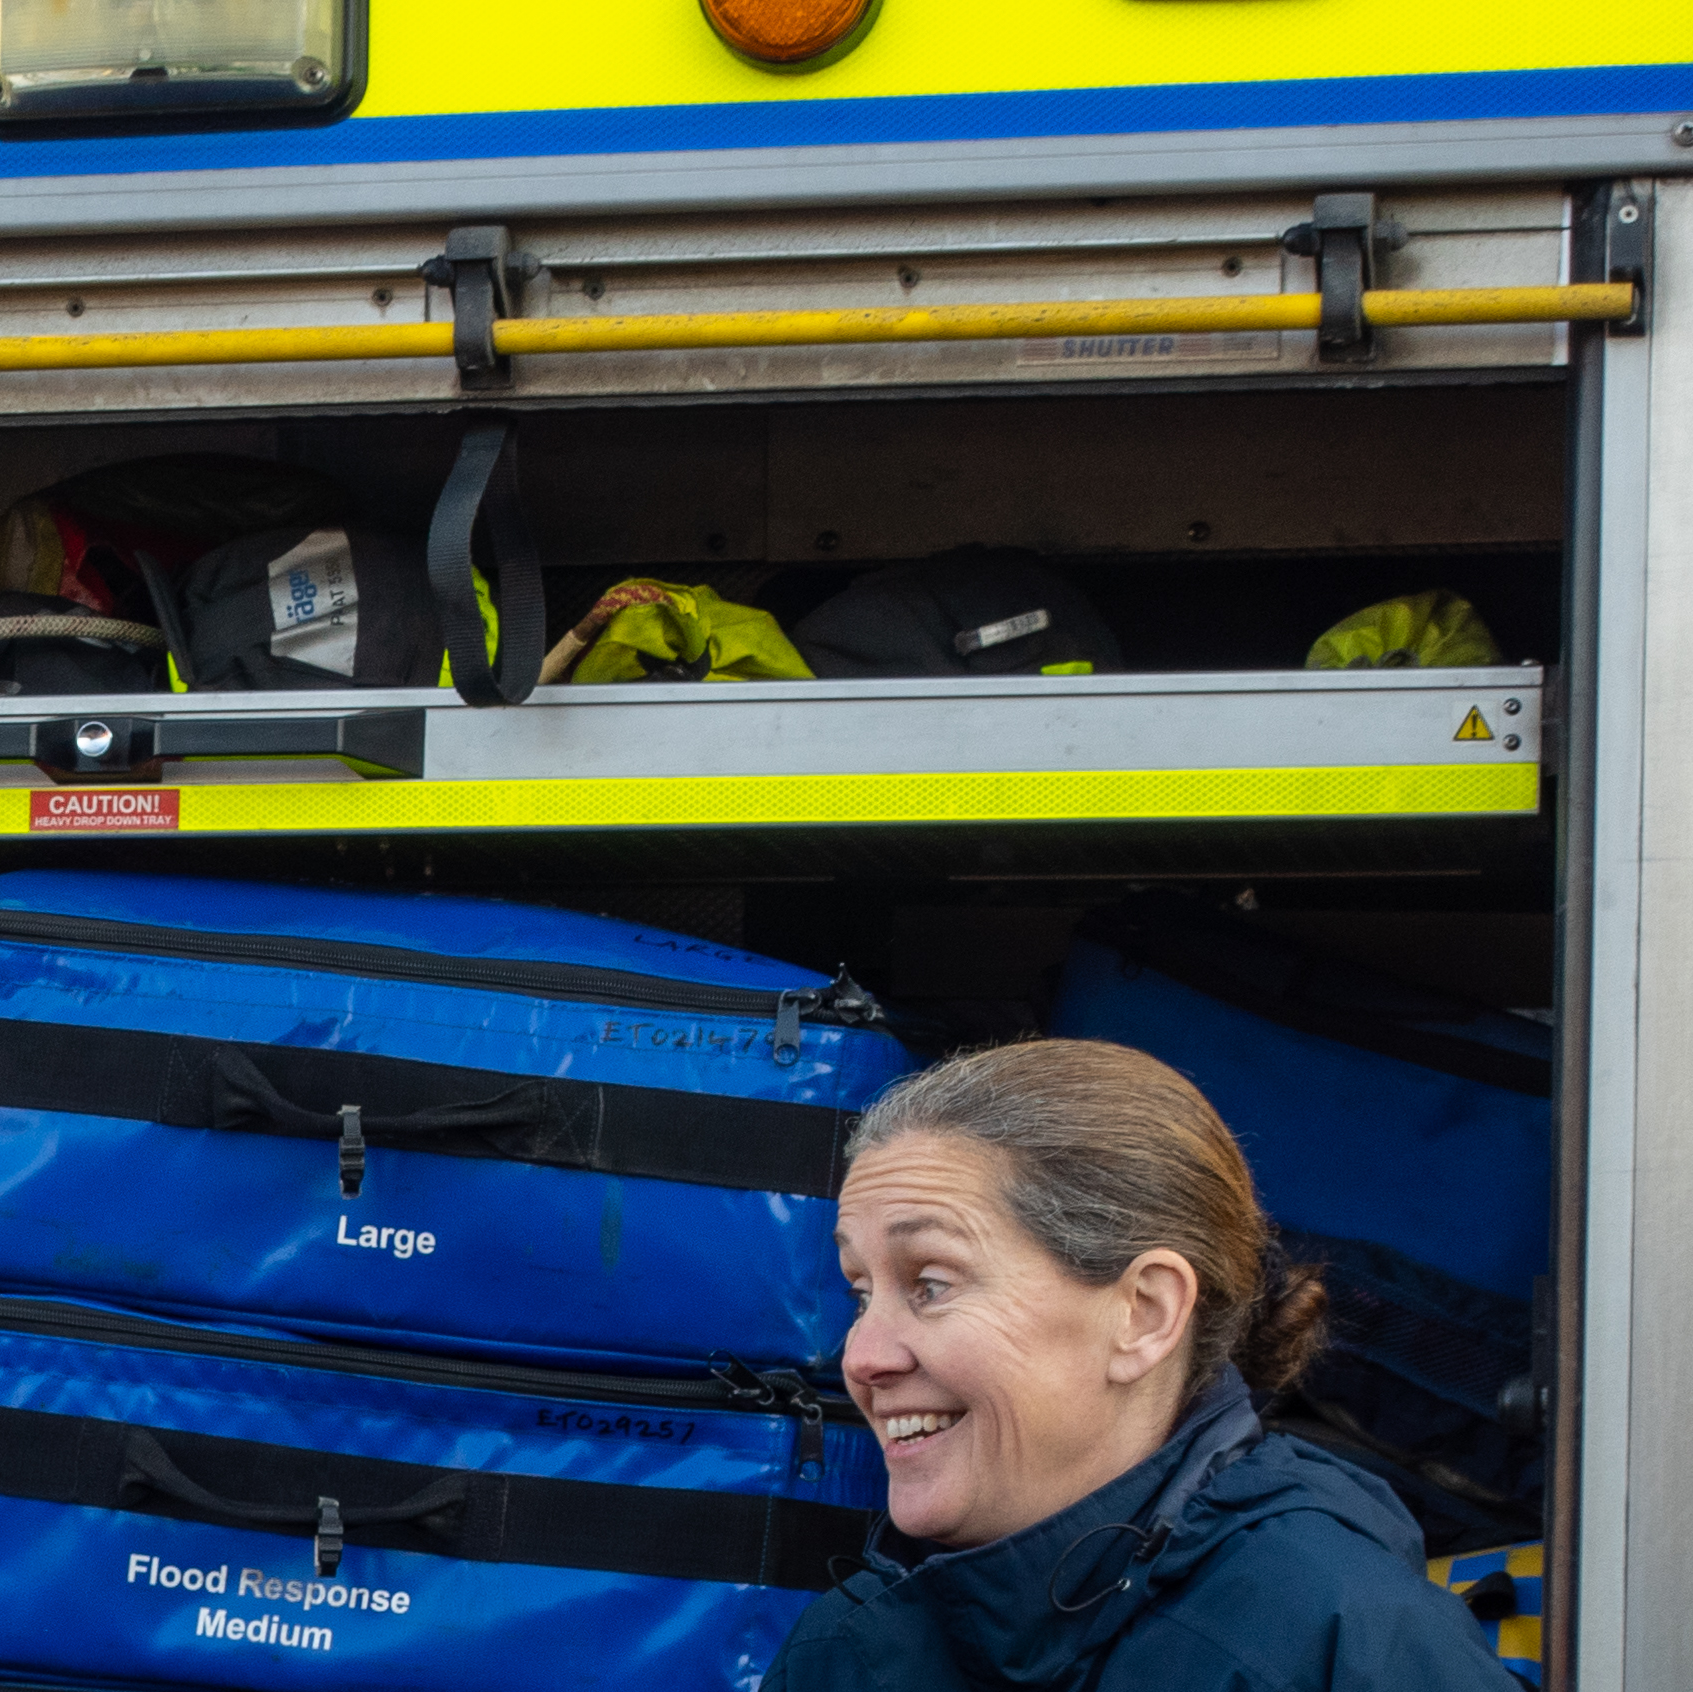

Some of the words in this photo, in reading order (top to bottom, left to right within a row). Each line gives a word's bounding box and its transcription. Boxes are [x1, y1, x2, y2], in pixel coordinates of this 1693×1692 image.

[1062, 336, 1176, 358] SHUTTER
[34, 816, 71, 827] HEAVY
[73, 816, 105, 827] DROP
[106, 815, 141, 826] DOWN
[142, 815, 172, 825] TRAY
[48, 794, 160, 815] CAUTION!
[336, 1214, 437, 1259] Large
[126, 1553, 228, 1594] Flood
[237, 1567, 411, 1615] Response
[195, 1606, 333, 1650] Medium
